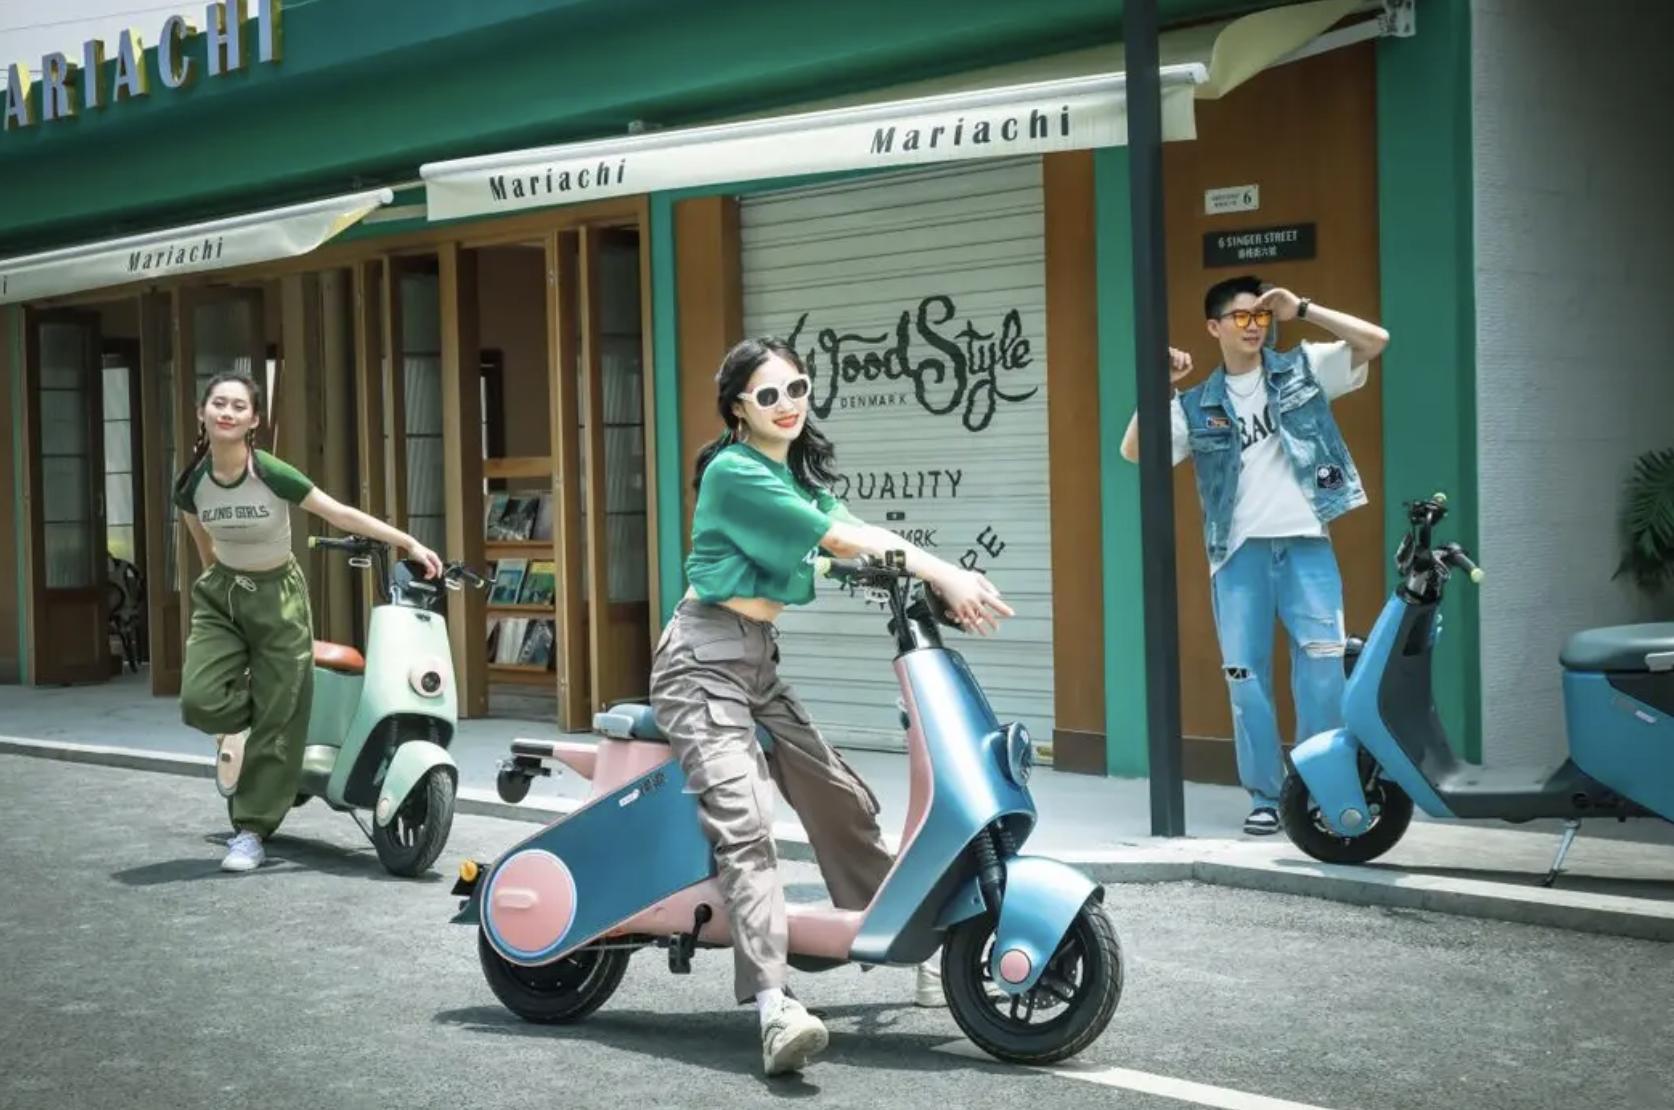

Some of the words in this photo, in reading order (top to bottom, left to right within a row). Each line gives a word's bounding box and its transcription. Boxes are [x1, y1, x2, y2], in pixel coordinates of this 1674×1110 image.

[870, 105, 1070, 154] Mariachi
[488, 158, 626, 201] Mariachi
[1243, 189, 1252, 205] 6
[1218, 236, 1226, 249] 6
[1227, 233, 1262, 248] SINGER
[1264, 230, 1298, 244] STREET
[127, 236, 223, 272] Mariachi
[841, 393, 908, 410] DENMARK
[831, 469, 963, 501] QUALITY
[202, 506, 233, 522] BLING
[235, 504, 270, 519] GIRLS
